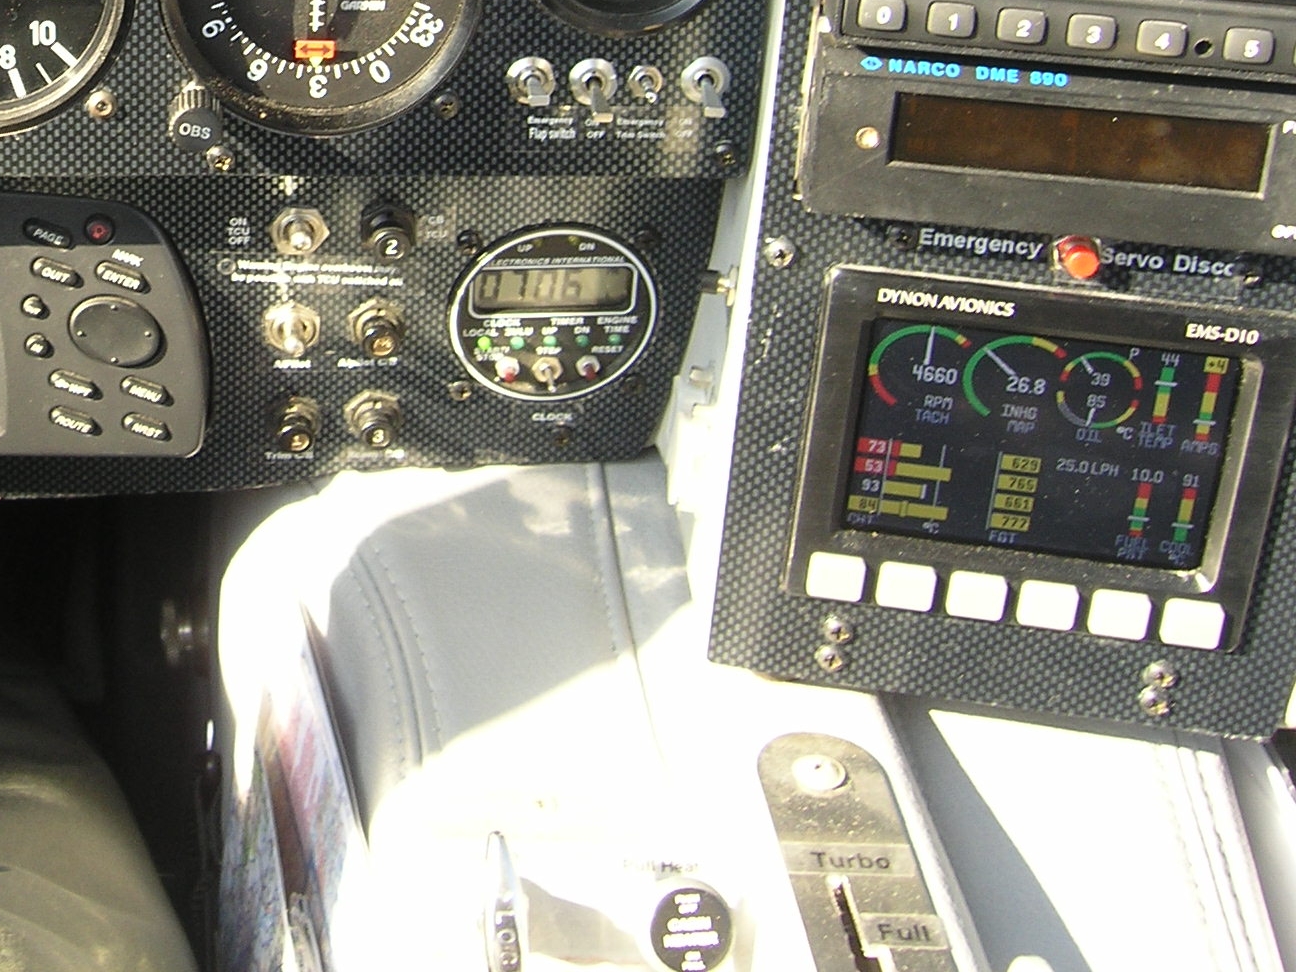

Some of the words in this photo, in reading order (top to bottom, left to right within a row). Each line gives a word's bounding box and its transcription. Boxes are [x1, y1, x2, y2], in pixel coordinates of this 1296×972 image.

[875, 6, 892, 24] 0
[29, 20, 56, 46] 10
[889, 59, 960, 78] NARCO
[975, 65, 1019, 84] DME
[1029, 71, 1069, 88] 890
[179, 122, 211, 140] OBS
[386, 239, 397, 254] 2
[551, 256, 625, 265] INTERNATIONAL
[41, 266, 70, 283] QUIT
[102, 270, 140, 290] ENTER
[877, 288, 937, 309] DYNON
[938, 294, 1017, 318] AVIONICS
[463, 328, 498, 337] LOCAL
[604, 325, 630, 333] TIME
[1185, 323, 1260, 346] EMS-D10
[1161, 354, 1180, 367] 44
[912, 364, 958, 385] 4660
[130, 385, 162, 402] MENU
[1006, 377, 1046, 395] 26.8
[923, 395, 953, 410] RPM
[55, 415, 91, 433] ROUTE
[532, 412, 573, 421] CLOCK
[915, 409, 950, 424] TACH
[809, 851, 891, 870] Turbo
[877, 923, 931, 943] Full
